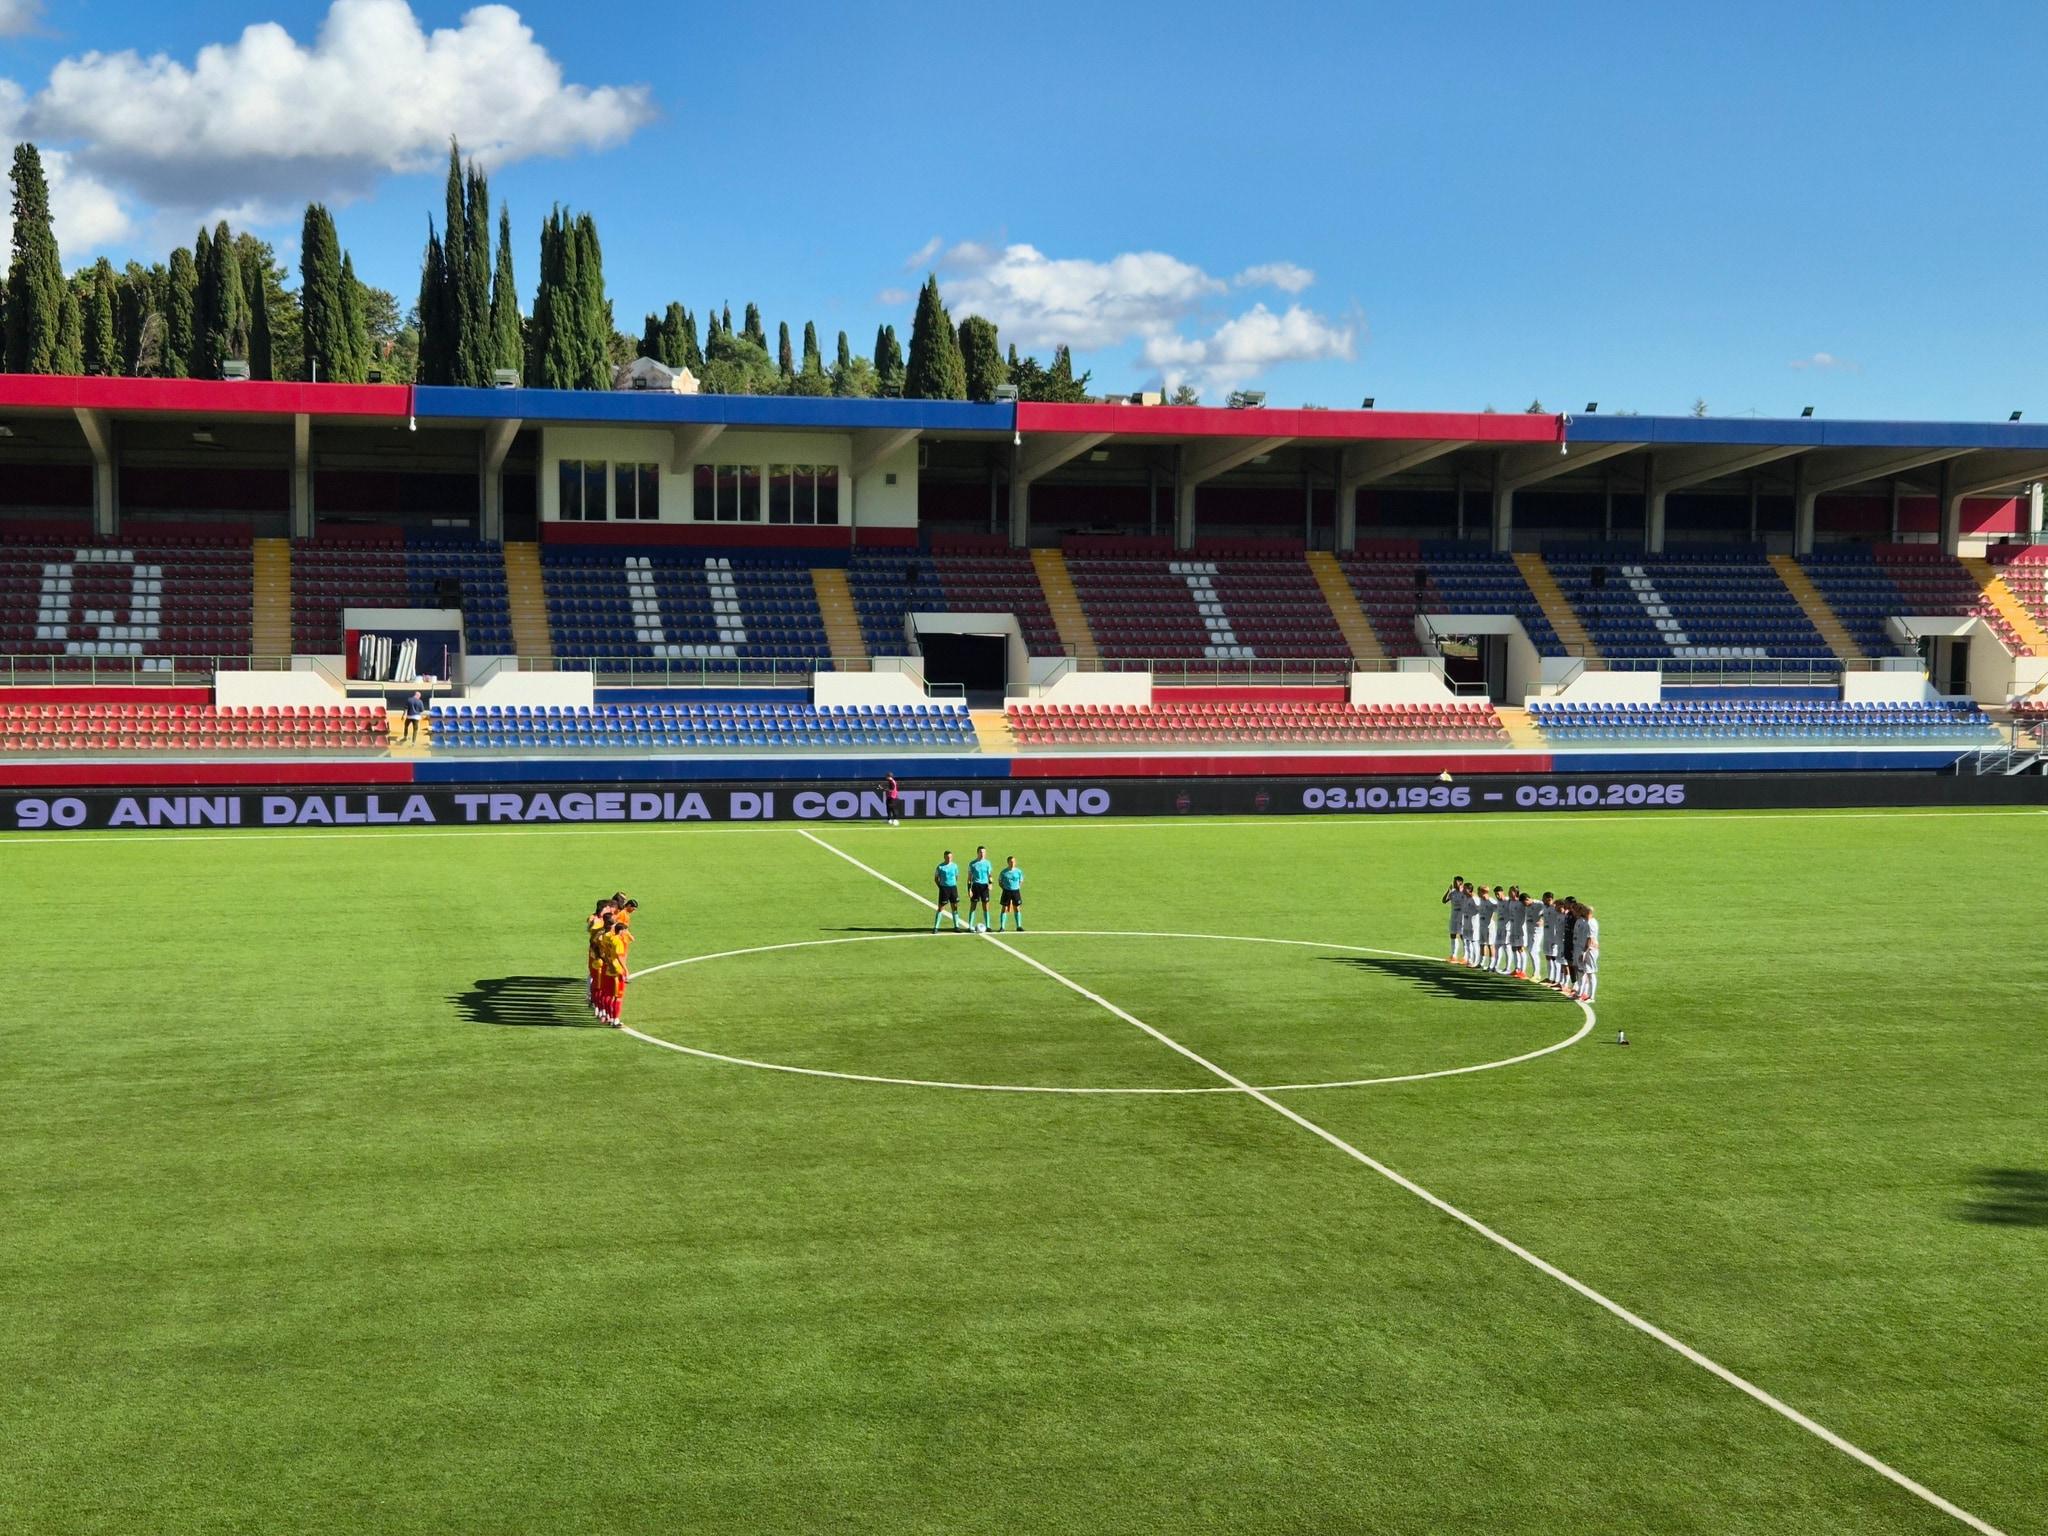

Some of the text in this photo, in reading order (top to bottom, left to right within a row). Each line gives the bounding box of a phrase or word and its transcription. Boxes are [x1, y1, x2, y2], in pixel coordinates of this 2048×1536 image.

[15, 789, 1111, 828] 90 ANNI DALLA TRAGEDIA DI CONTIGLIANO
[1302, 786, 1472, 811] 03.10.1936
[1515, 784, 1686, 808] 03.10.2026
